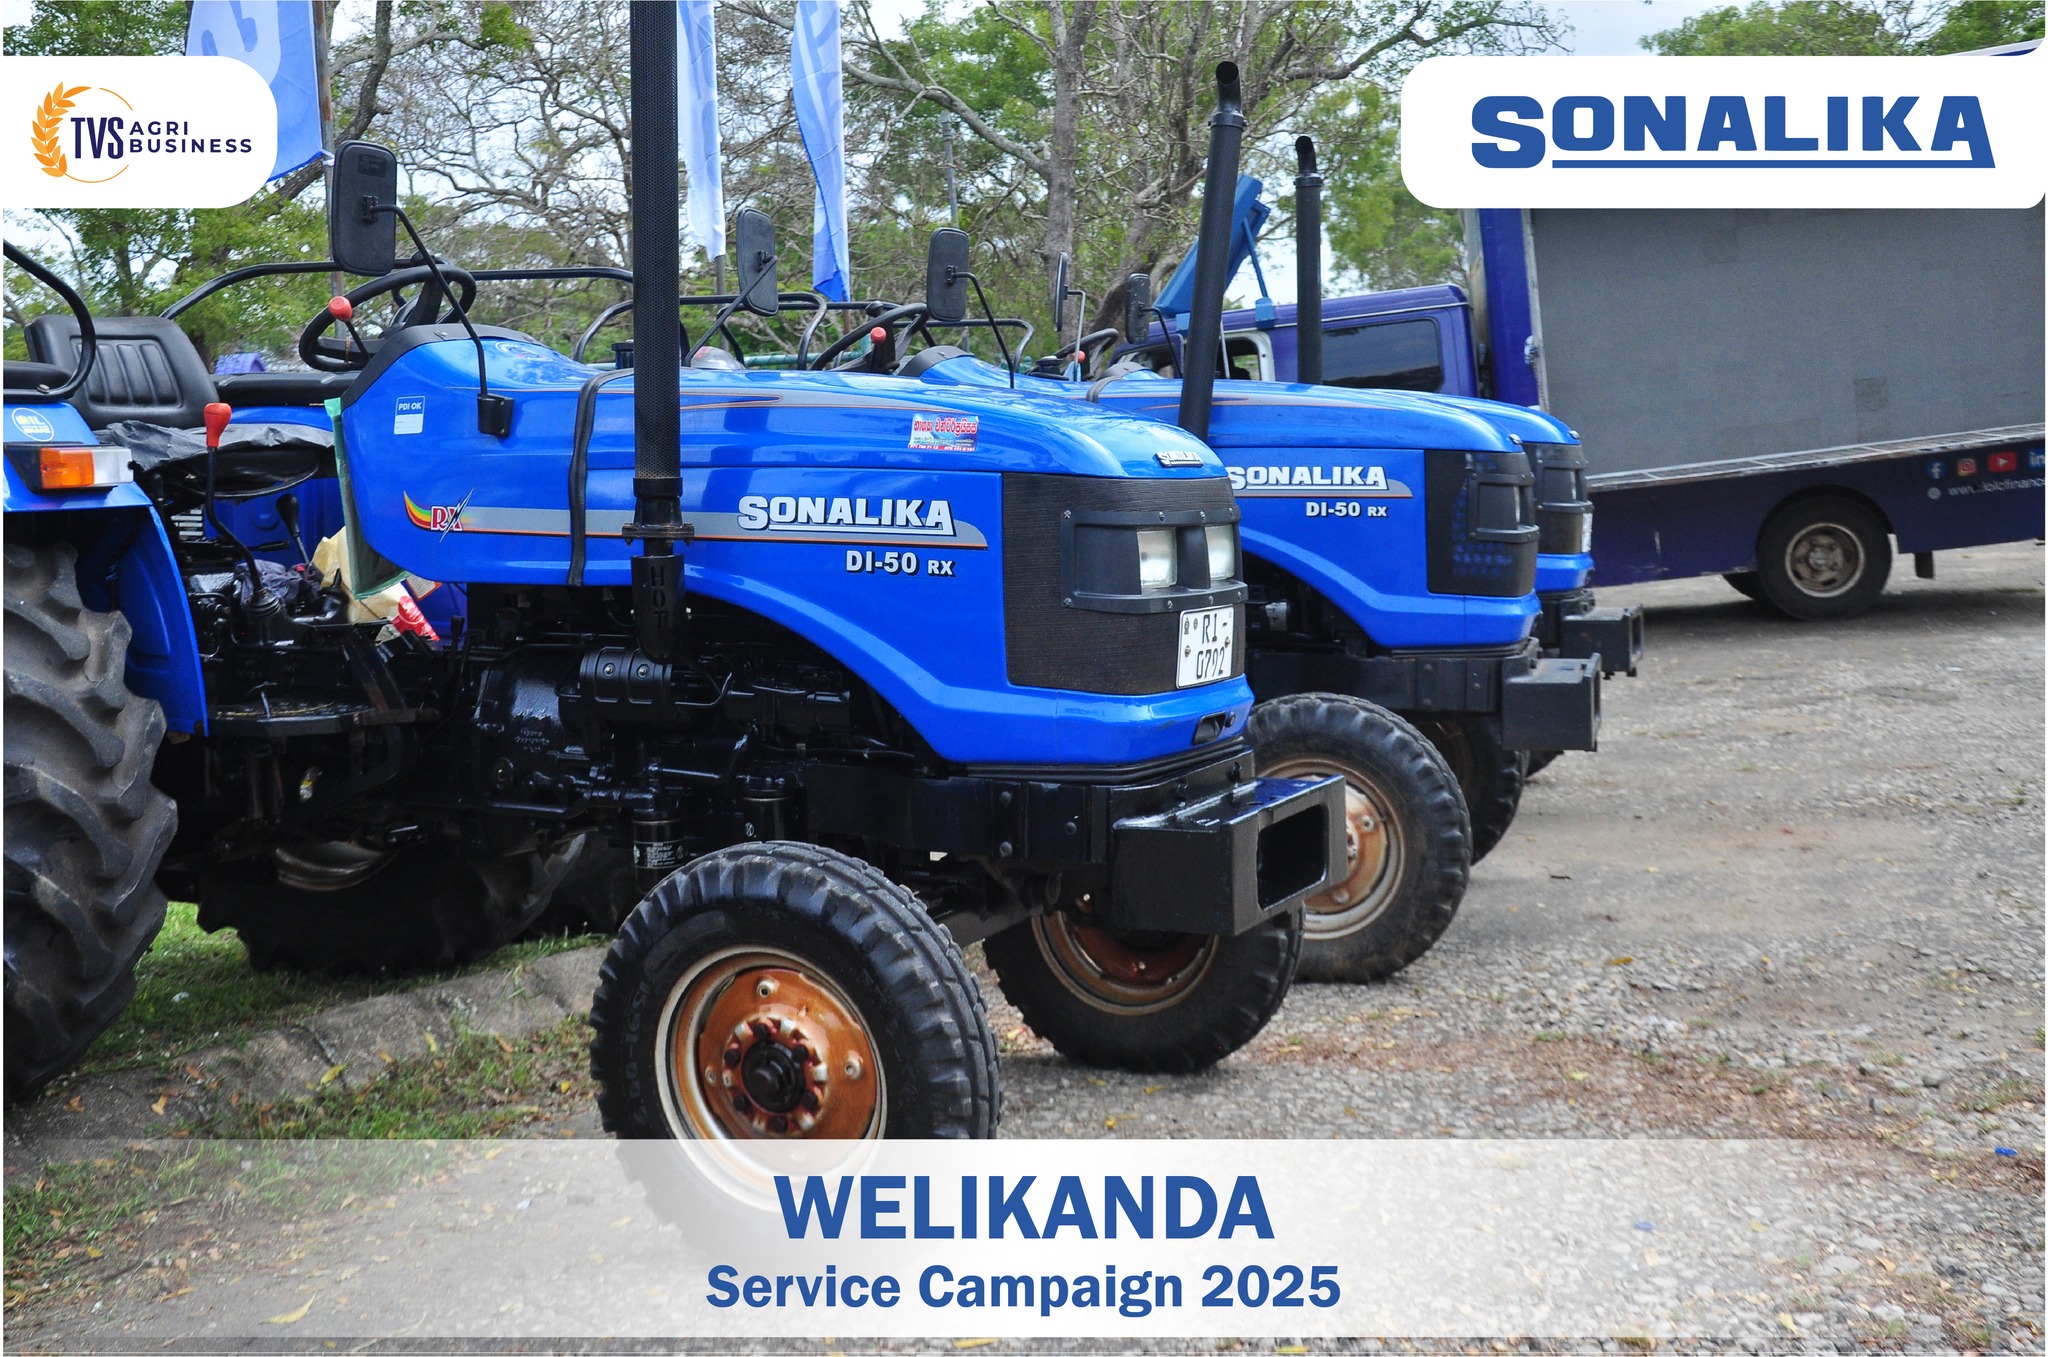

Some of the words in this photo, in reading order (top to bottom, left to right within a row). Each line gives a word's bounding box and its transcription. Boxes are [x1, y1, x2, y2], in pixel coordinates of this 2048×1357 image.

[411, 402, 422, 410] OK
[1227, 466, 1389, 490] SONALIKA
[737, 495, 956, 537] SONALIKA
[1305, 501, 1362, 518] DI-50
[1367, 506, 1388, 518] RX
[845, 550, 919, 575] DI-50
[927, 559, 955, 577] RX
